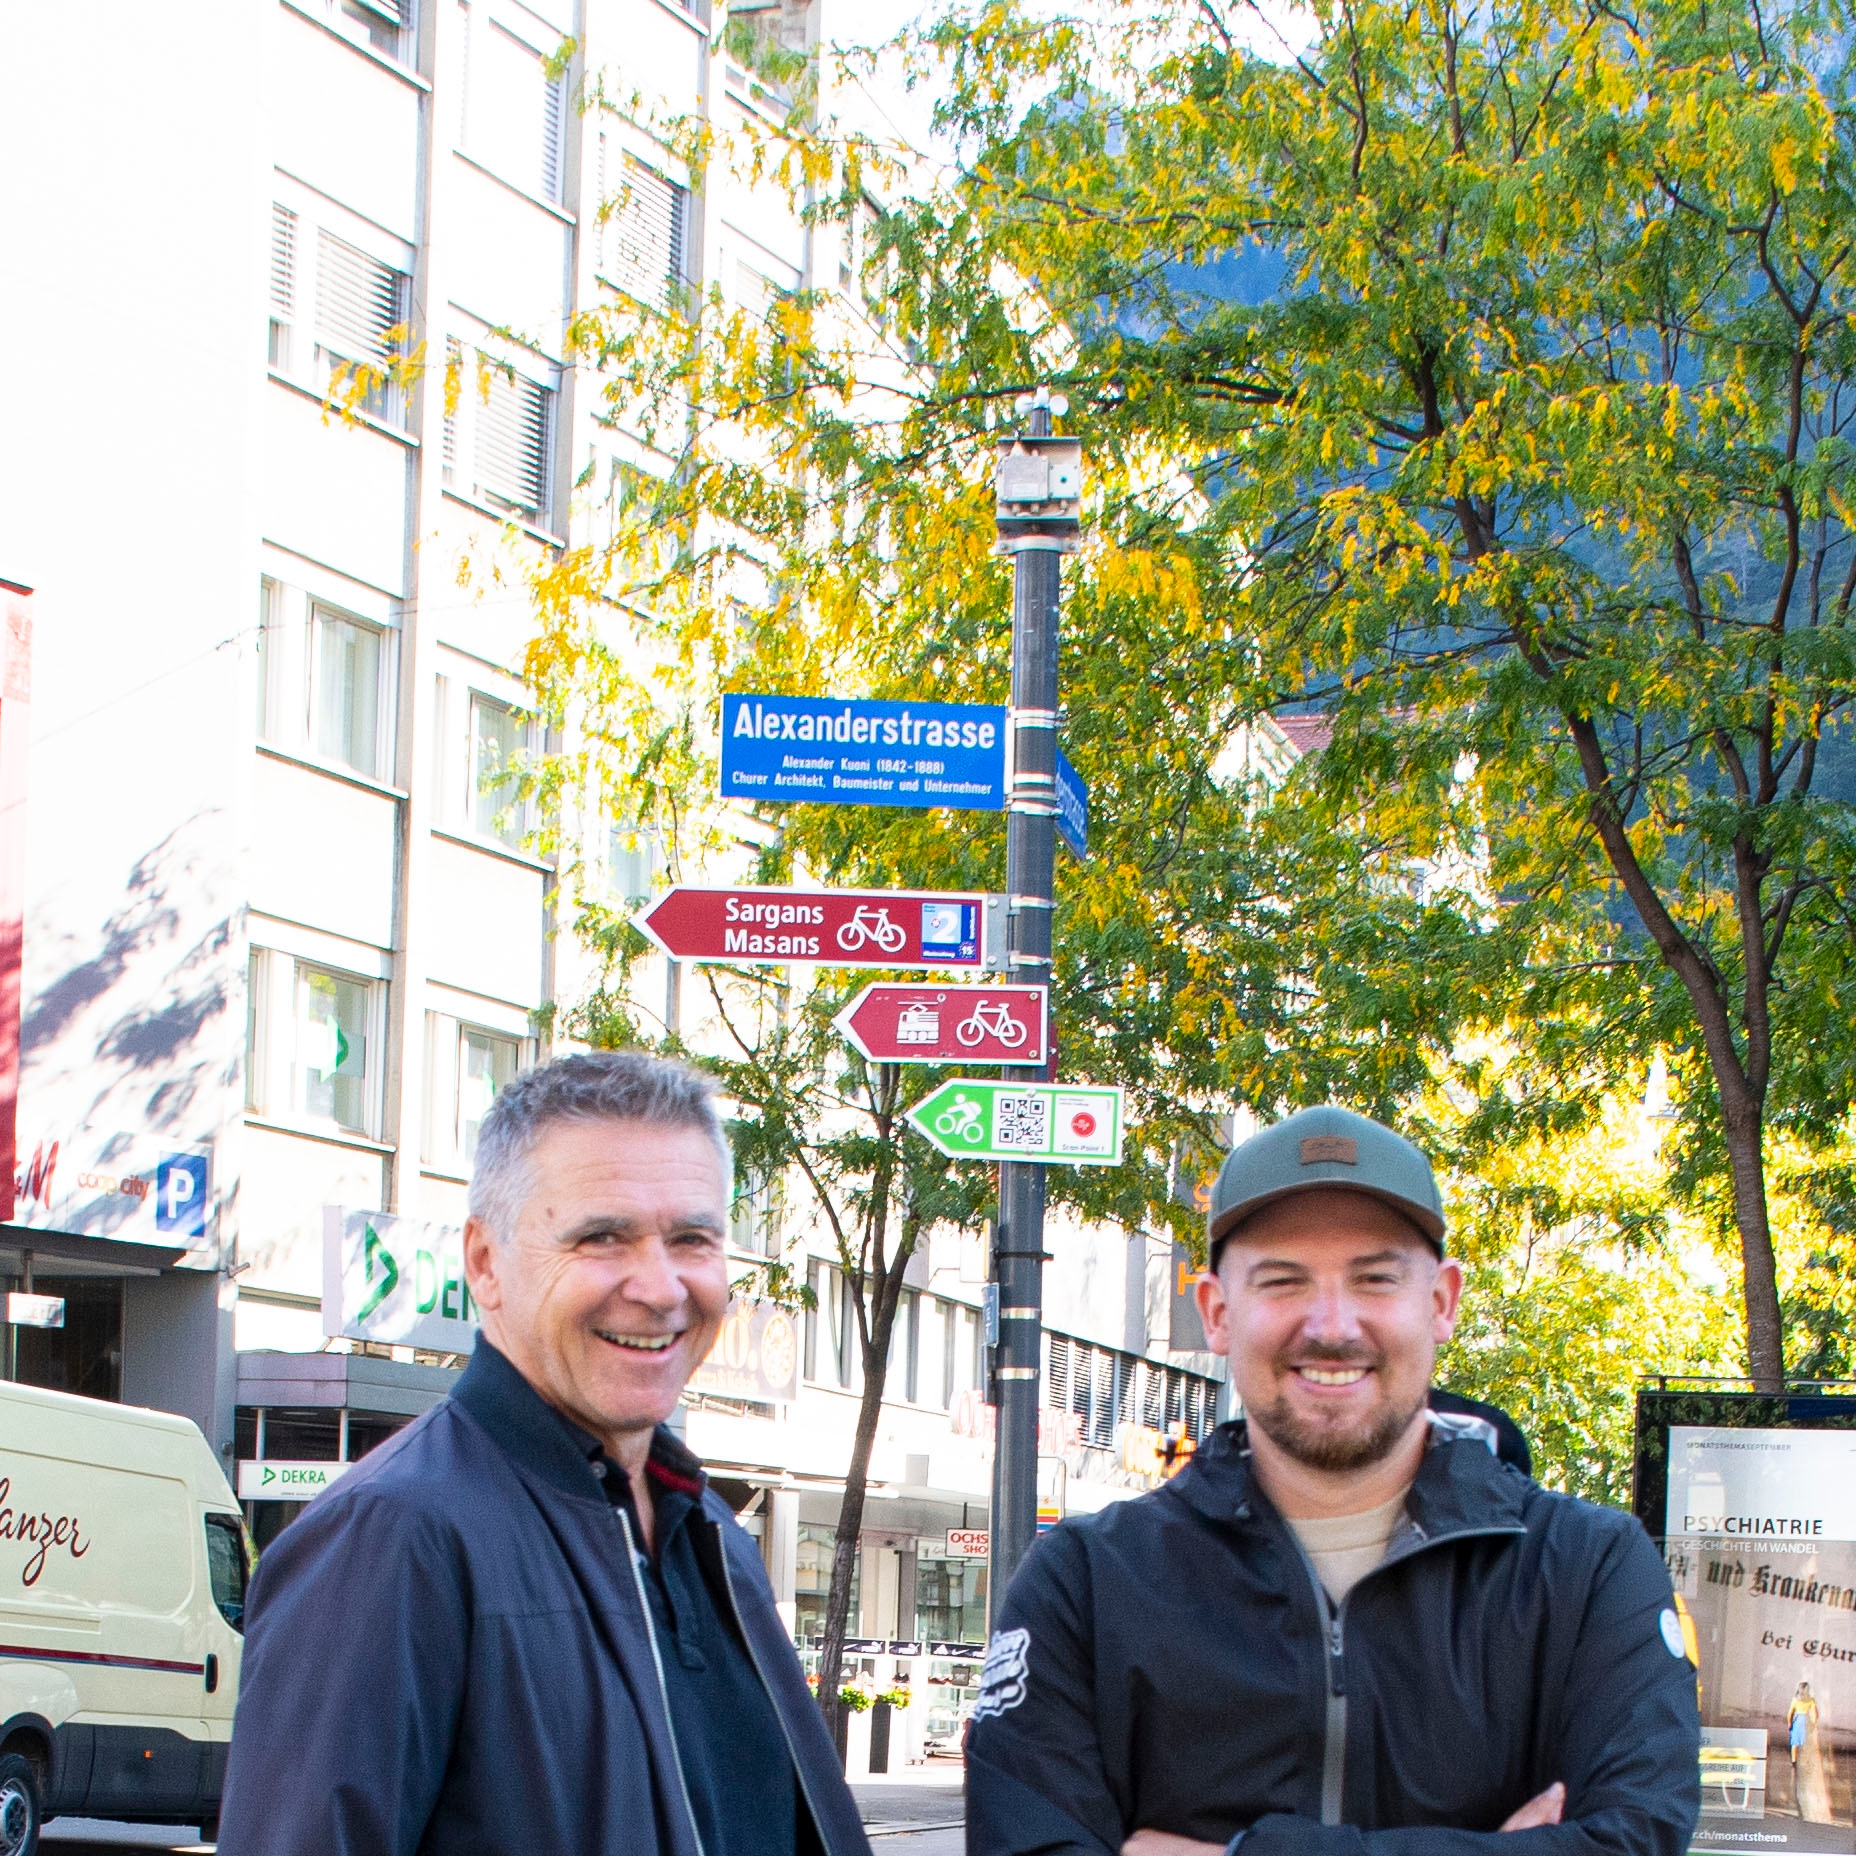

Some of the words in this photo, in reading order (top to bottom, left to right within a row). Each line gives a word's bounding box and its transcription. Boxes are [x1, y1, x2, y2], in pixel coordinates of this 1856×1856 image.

[732, 702, 994, 749] Alexanderstrasse
[781, 755, 835, 771] Alexander
[840, 757, 870, 771] Kuoni
[732, 771, 769, 786] Churer
[774, 773, 827, 789] Architekt,
[833, 775, 894, 791] Baumeister
[899, 780, 920, 793] und
[924, 781, 992, 796] Unternehmer
[725, 897, 824, 930] Sargans
[932, 909, 959, 944] 2
[724, 928, 819, 956] Masans
[120, 1174, 150, 1202] city
[167, 1167, 195, 1219] P
[281, 1469, 327, 1484] DEKRA
[1683, 1515, 1824, 1536] PSYCHIATRIE
[1681, 1540, 1751, 1553] GESCHICHTE
[1753, 1543, 1768, 1553] IM
[1769, 1543, 1820, 1555] WANDEL
[1705, 1560, 1745, 1588] und
